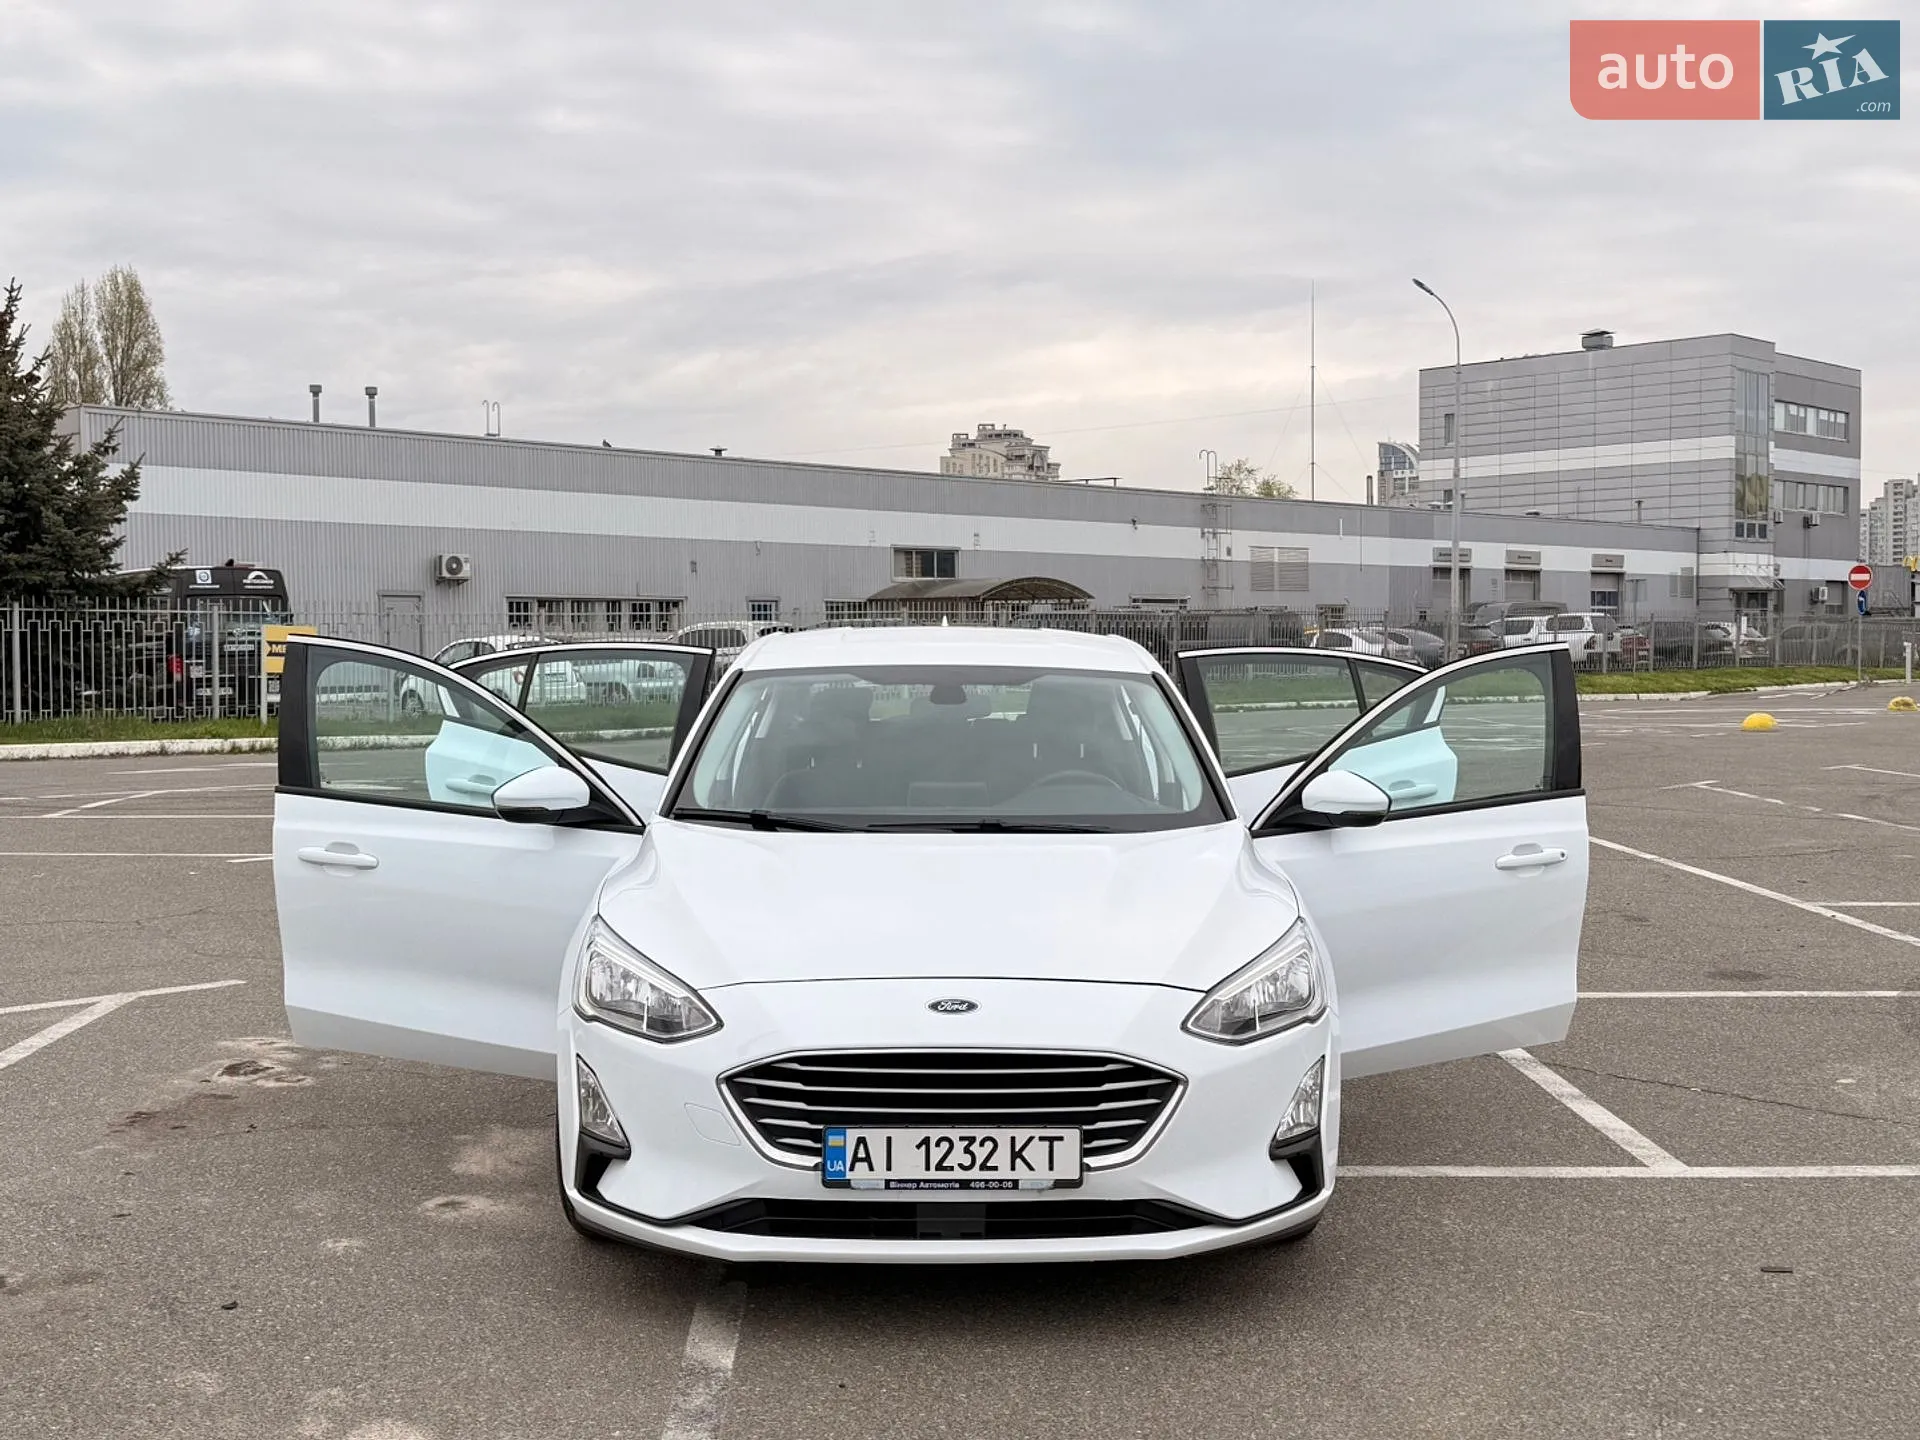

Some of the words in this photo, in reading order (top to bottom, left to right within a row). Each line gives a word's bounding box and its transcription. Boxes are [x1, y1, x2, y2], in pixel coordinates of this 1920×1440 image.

[937, 1001, 969, 1011] Ford
[849, 1136, 893, 1172] AI
[915, 1136, 1000, 1172] 1232
[1009, 1136, 1065, 1172] KT
[827, 1160, 845, 1172] UA
